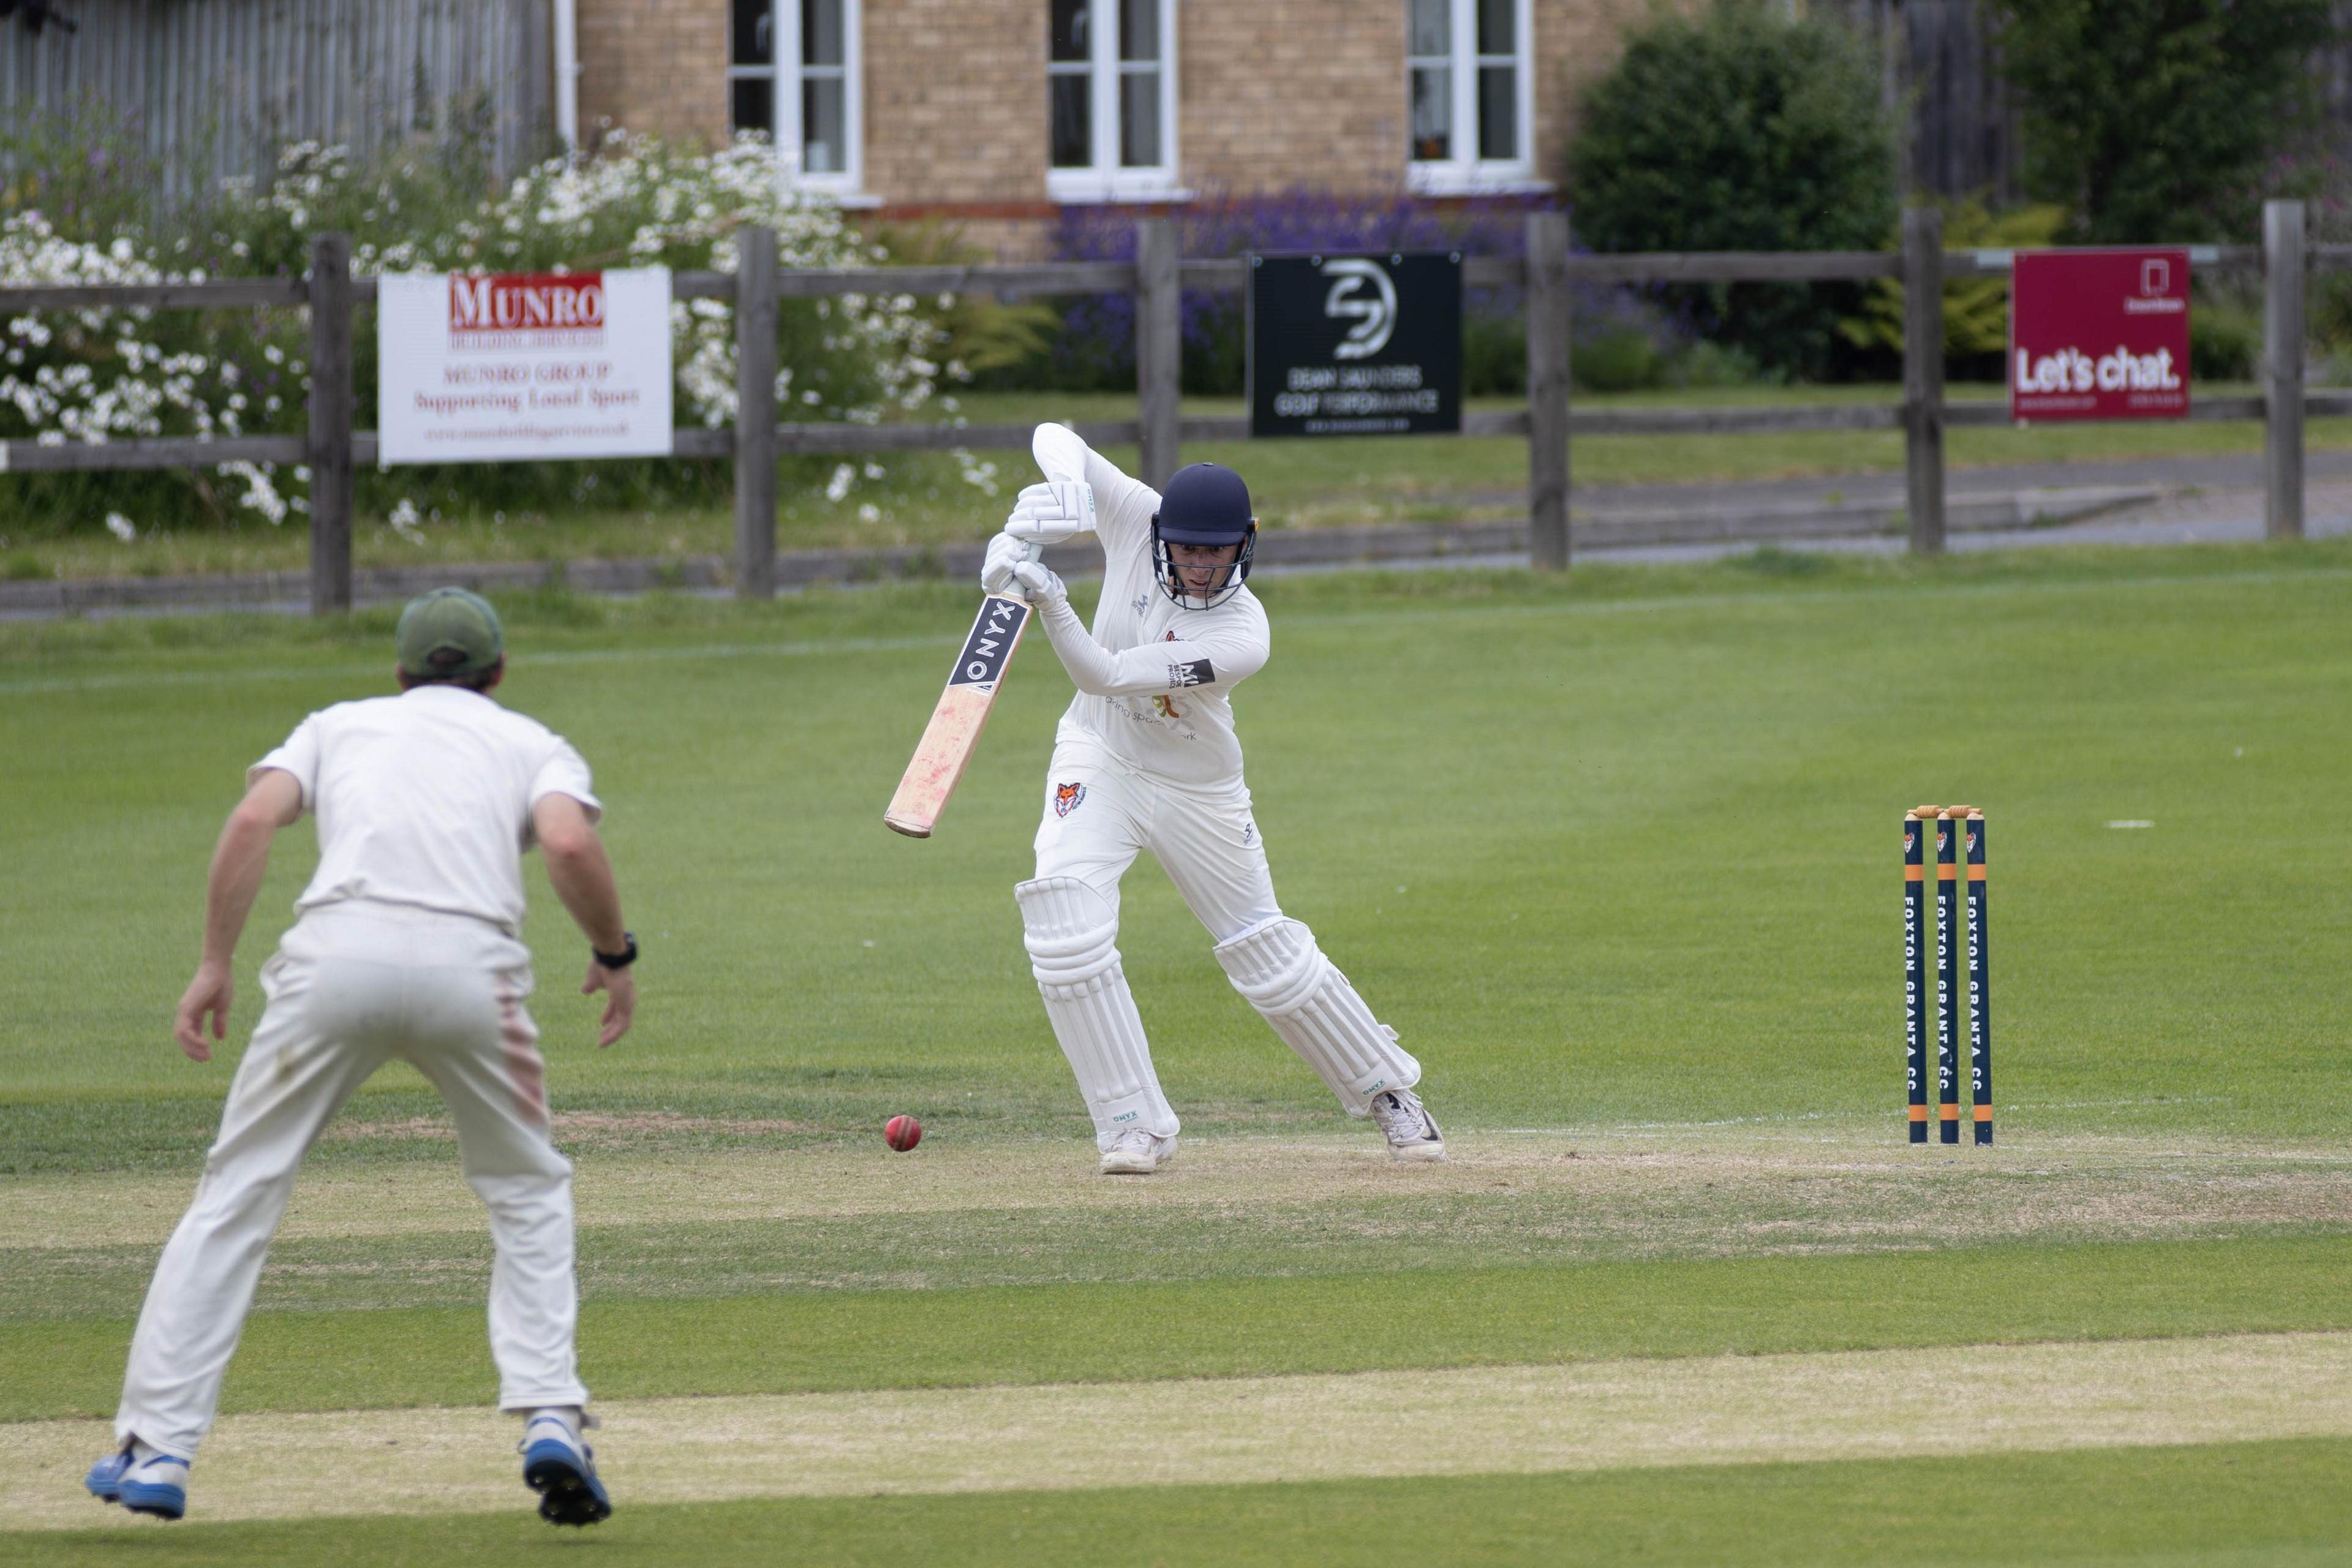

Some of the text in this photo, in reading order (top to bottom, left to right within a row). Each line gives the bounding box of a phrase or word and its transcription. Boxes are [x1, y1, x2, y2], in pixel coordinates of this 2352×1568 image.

[452, 277, 602, 330] MUNRO
[444, 362, 611, 383] MUNRO GROUP
[2016, 345, 2180, 393] Let's chat.
[416, 385, 639, 415] Supporting Local Sport
[967, 601, 1016, 680] ONYX
[1905, 897, 1917, 1090] FOXTON GRANTA CC
[1938, 895, 1949, 1089] FOXTON GRANTA CC
[1968, 897, 1982, 1090] FOXTON GRANTA CC
[1363, 1079, 1385, 1095] ONYX
[1114, 1110, 1137, 1122] ONYX
